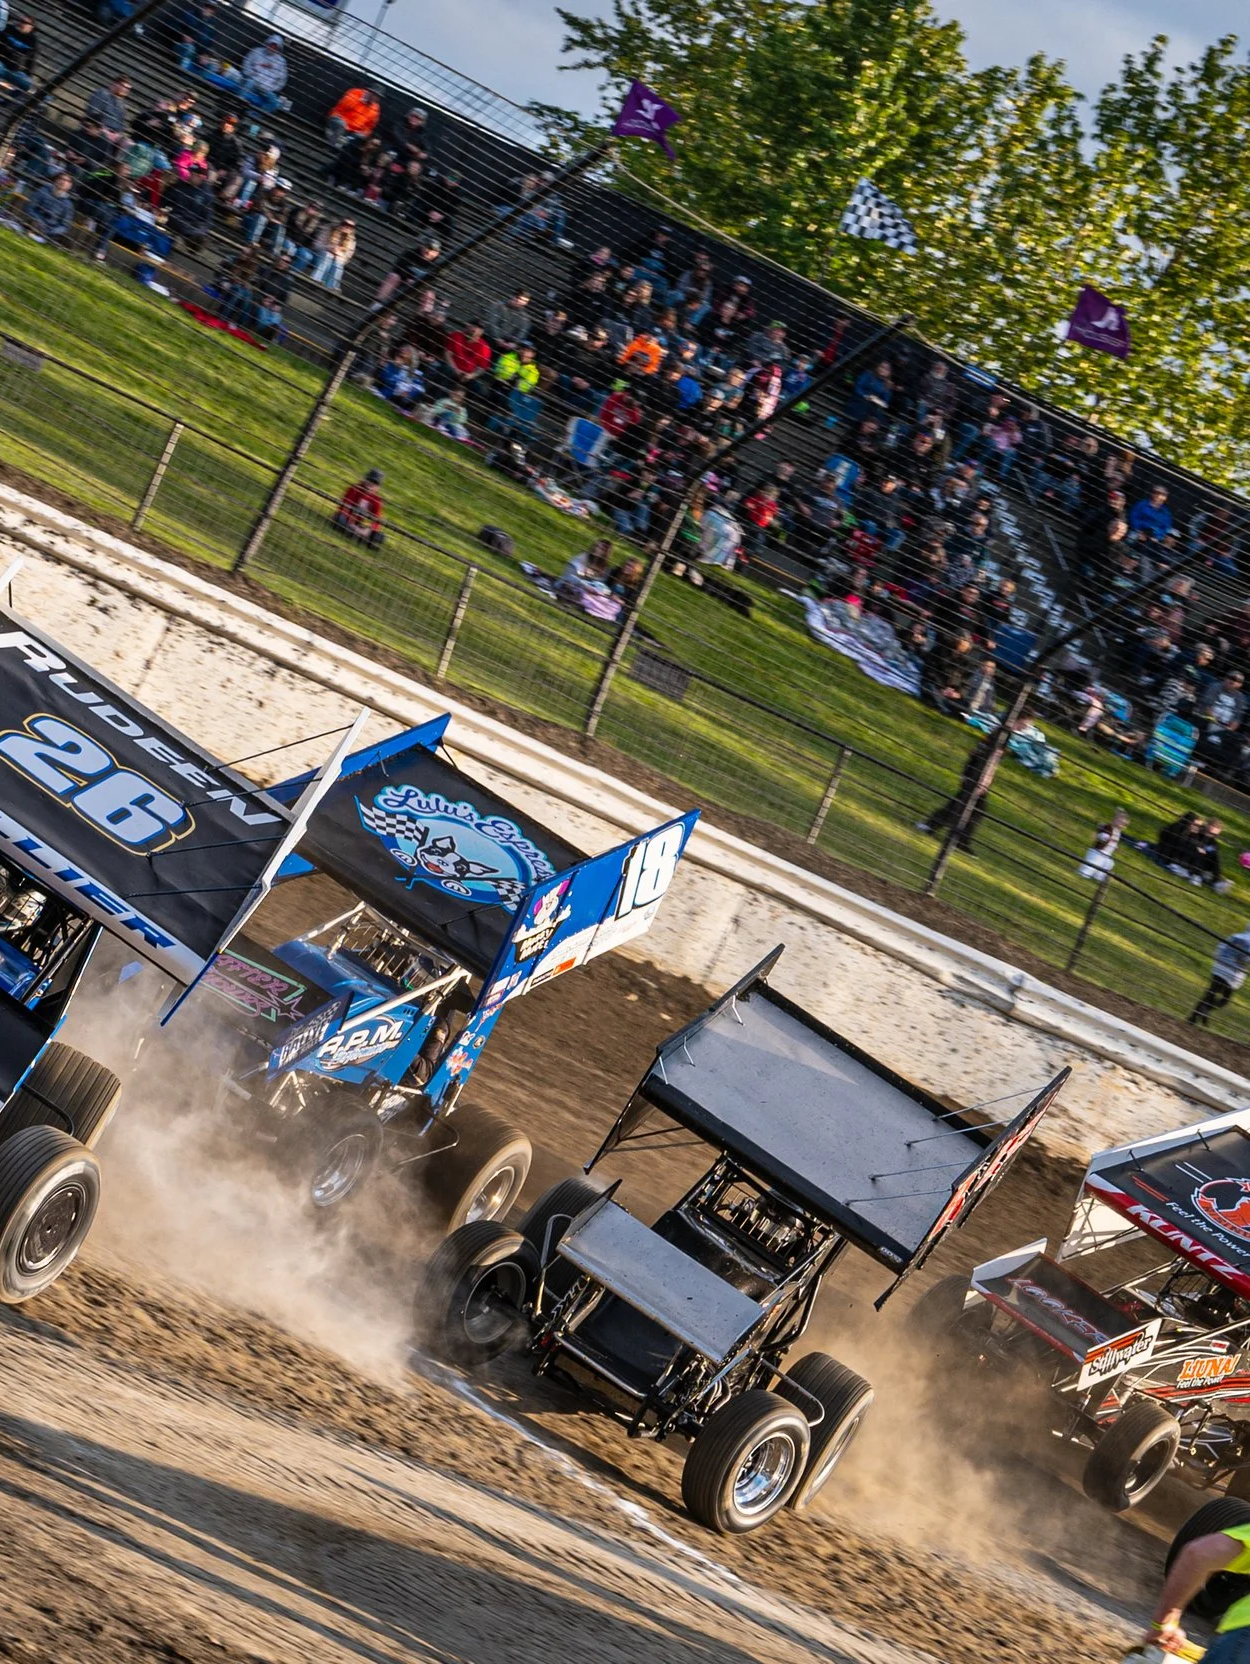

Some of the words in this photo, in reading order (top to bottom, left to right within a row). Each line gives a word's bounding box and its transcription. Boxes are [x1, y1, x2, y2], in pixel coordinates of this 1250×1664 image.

[381, 787, 476, 823] Lulu's
[614, 822, 687, 921] 18
[1126, 1203, 1243, 1280] KUNTZ
[1166, 1202, 1195, 1218] Feel
[1191, 1218, 1213, 1233] the
[1212, 1231, 1250, 1257] Power
[1088, 1331, 1154, 1376] Stillwater
[1177, 1380, 1191, 1389] Feel
[1191, 1377, 1204, 1388] the
